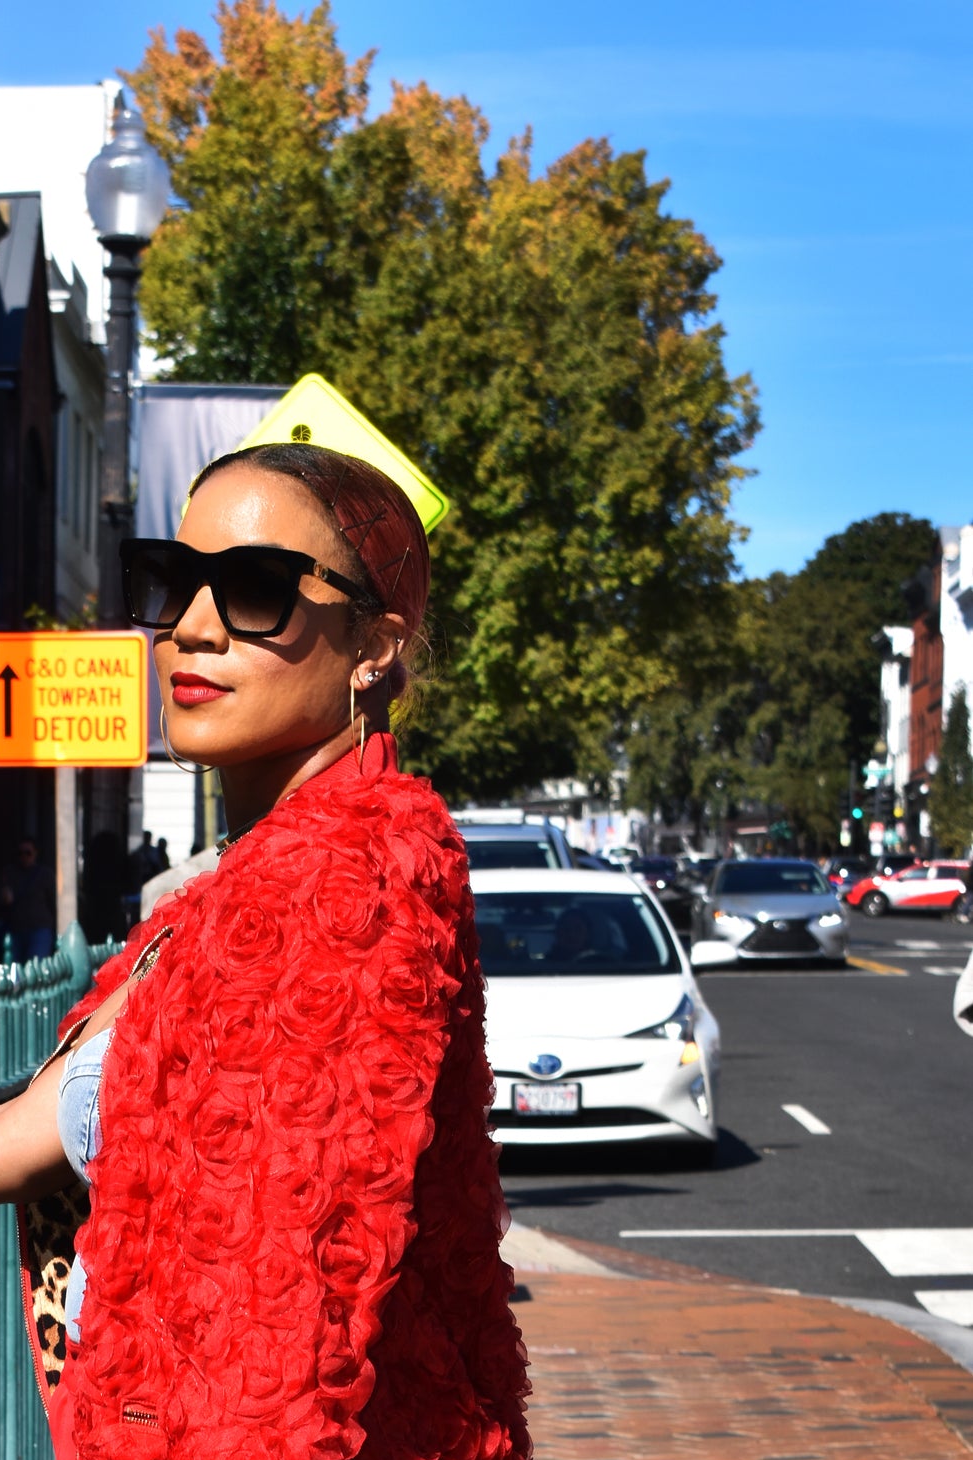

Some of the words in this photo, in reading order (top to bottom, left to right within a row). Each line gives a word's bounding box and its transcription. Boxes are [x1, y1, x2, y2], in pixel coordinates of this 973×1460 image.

[24, 658, 67, 678] C&O
[74, 658, 134, 678] CANAL
[38, 687, 121, 707] TOWPATH
[33, 716, 127, 742] DETOUR
